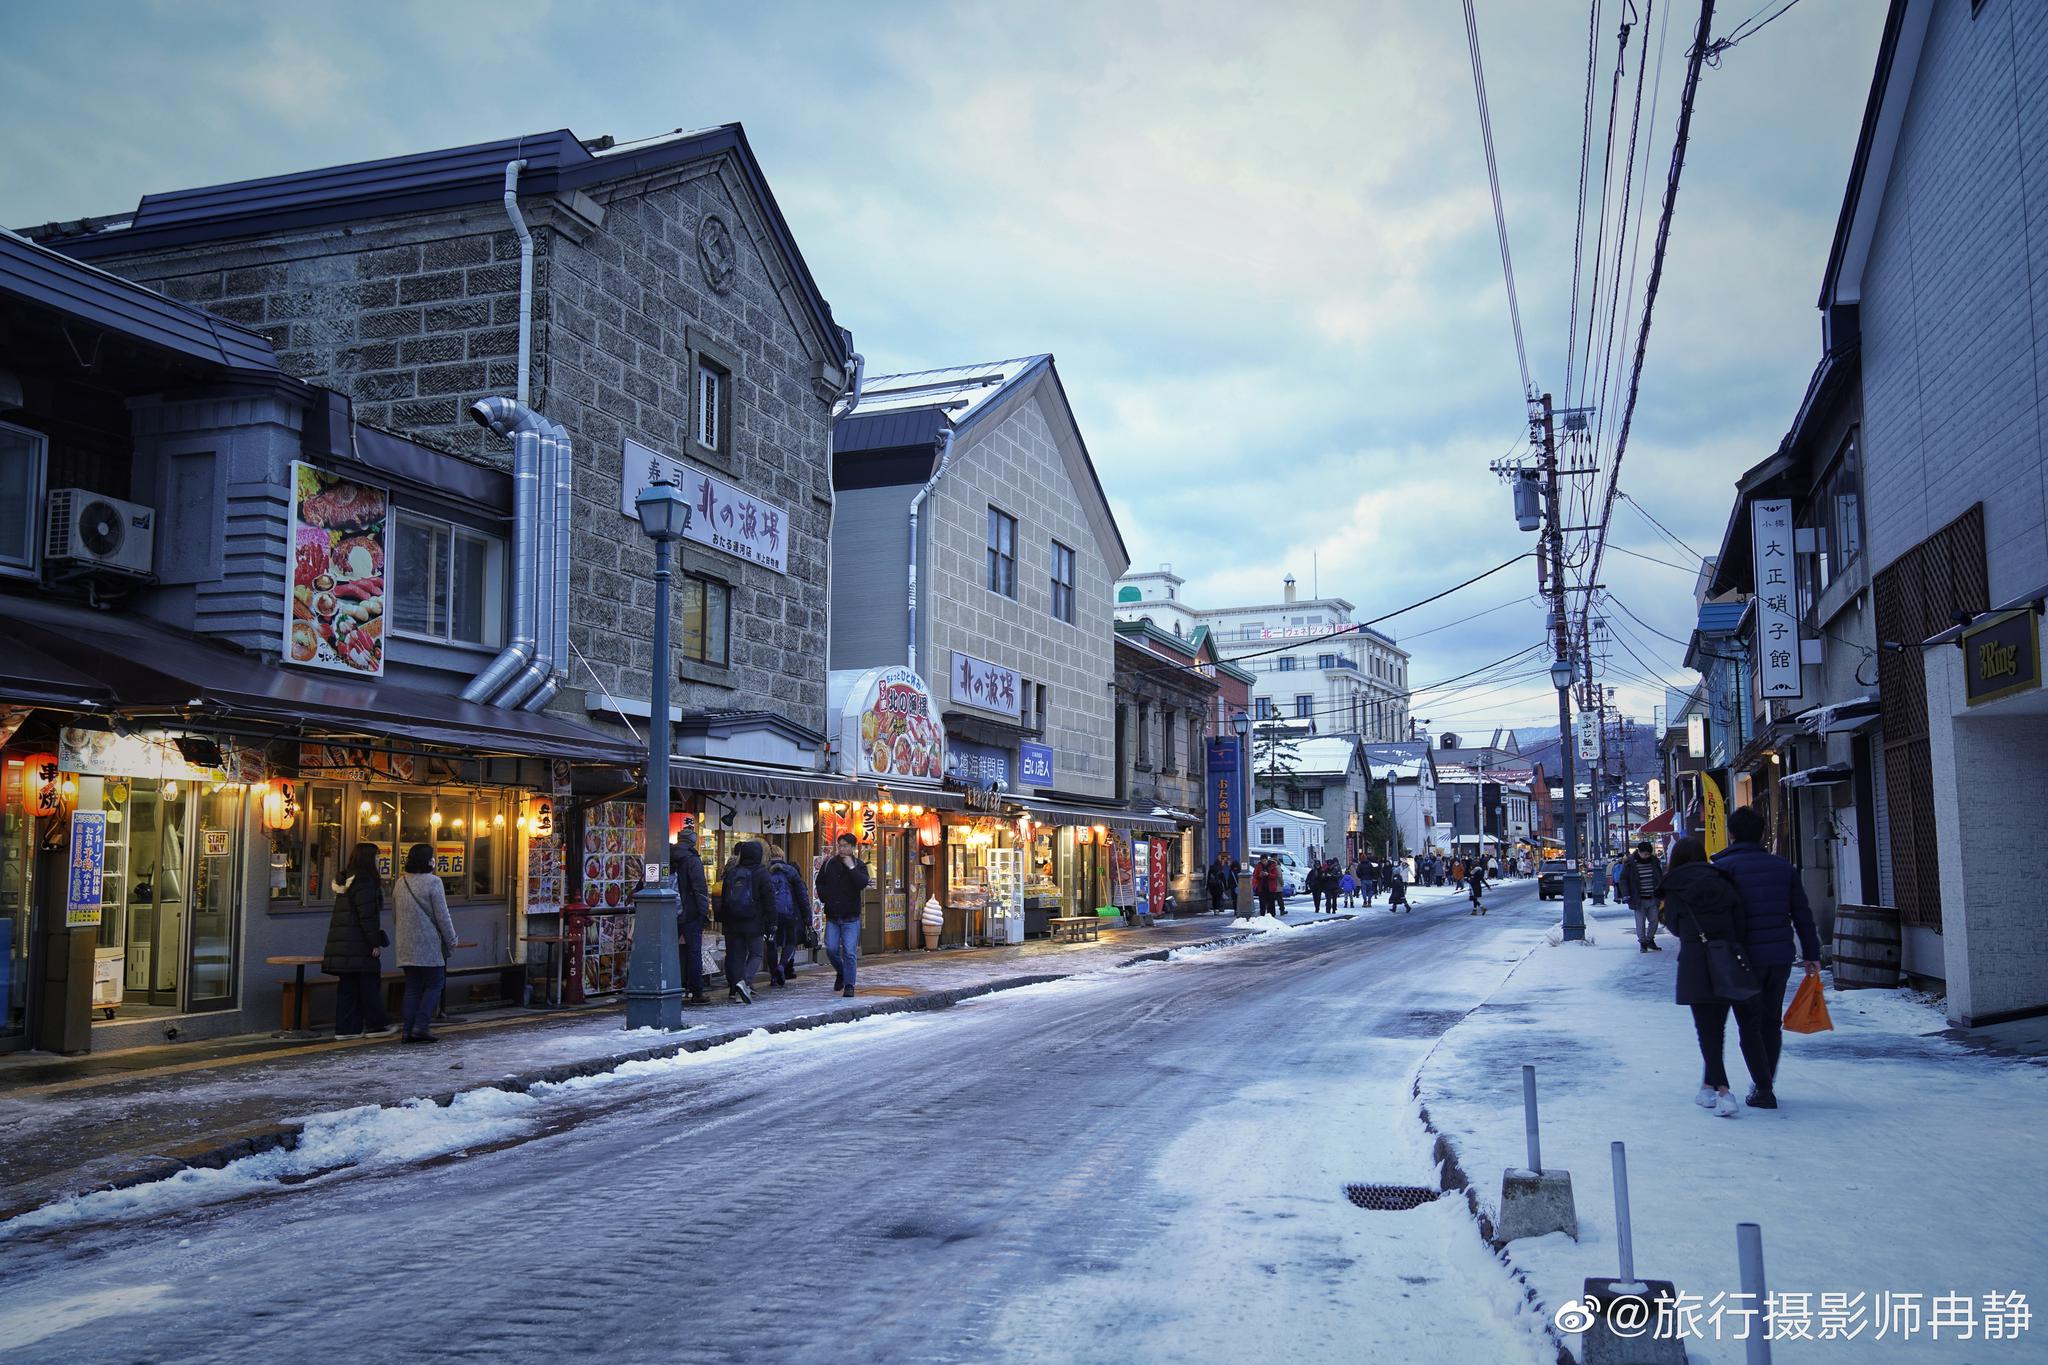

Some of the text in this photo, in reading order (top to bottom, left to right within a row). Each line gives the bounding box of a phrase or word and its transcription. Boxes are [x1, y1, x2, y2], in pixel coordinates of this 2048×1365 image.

[697, 477, 781, 553] 北の漁場
[1765, 540, 1791, 669] 大正硝子館
[960, 658, 1015, 710] 北の漁場
[889, 688, 929, 717] 北の漁場
[1023, 757, 1050, 777] 白い恋人
[208, 834, 226, 843] STAFF
[209, 844, 224, 853] ONLY
[437, 855, 463, 873] 売店
